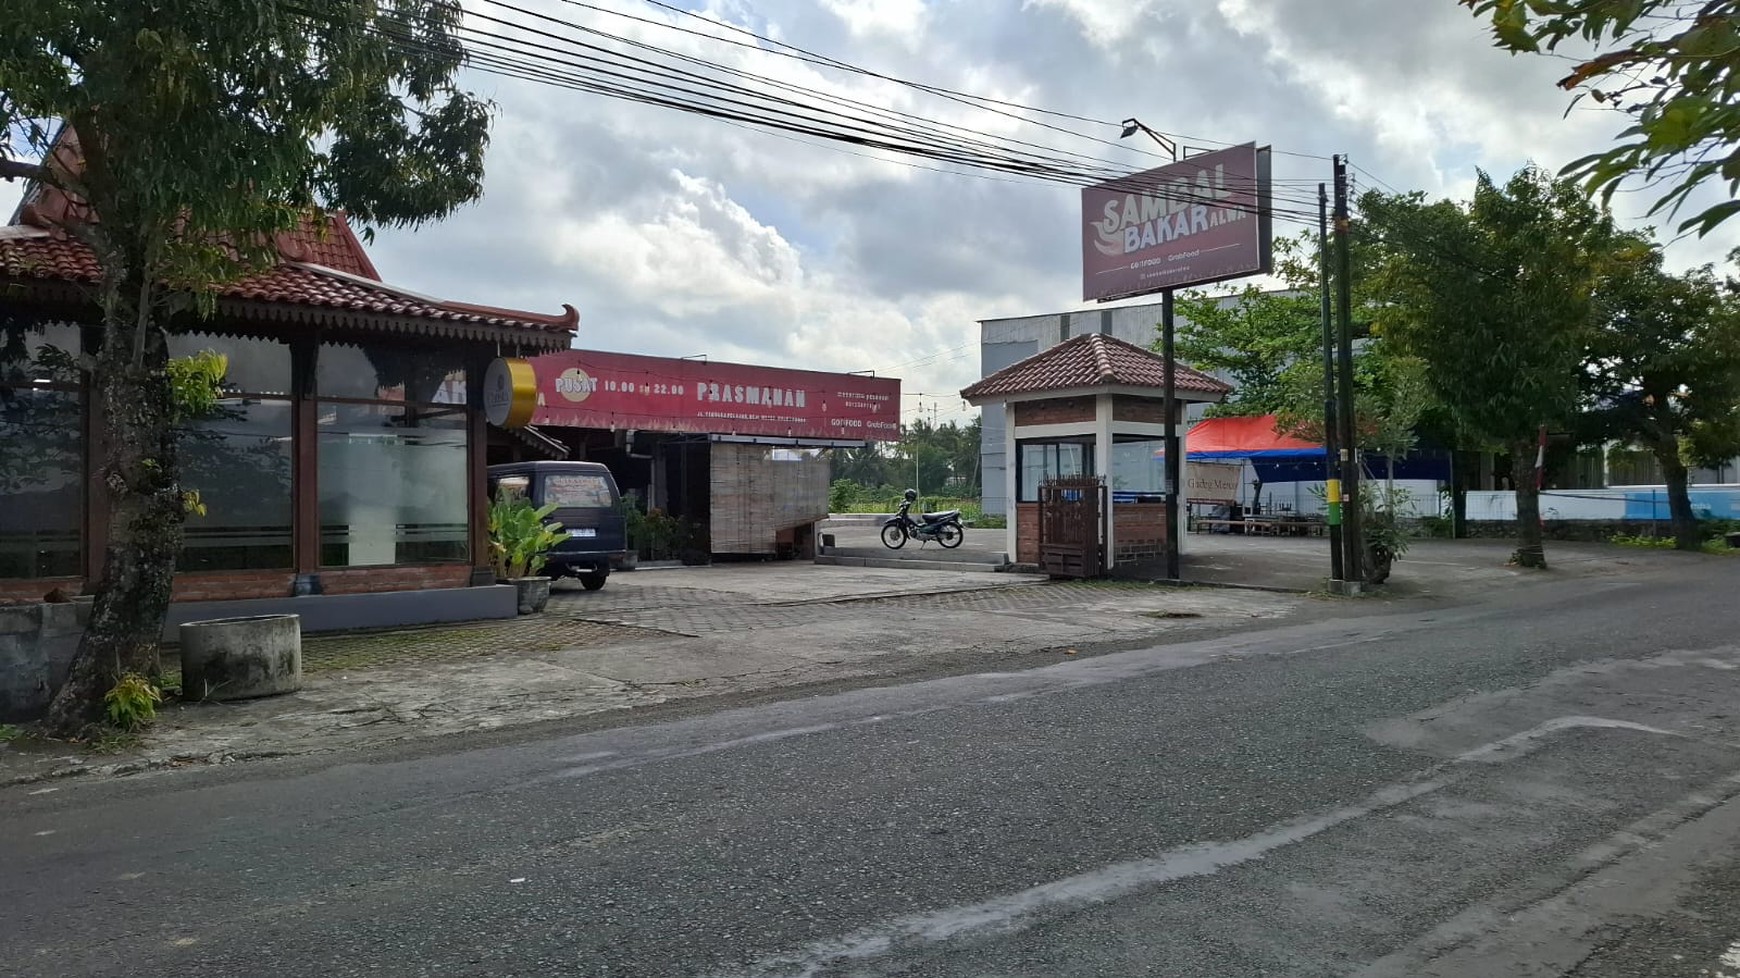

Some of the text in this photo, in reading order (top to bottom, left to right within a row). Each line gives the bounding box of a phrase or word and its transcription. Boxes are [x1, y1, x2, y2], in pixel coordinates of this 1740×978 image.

[1103, 163, 1231, 233] SAMBAL
[1124, 203, 1209, 254] BAKAR
[555, 377, 598, 393] PUSAT
[605, 381, 635, 393] 10.00
[654, 383, 684, 396] 22.00
[697, 382, 805, 408] PRASMANAN
